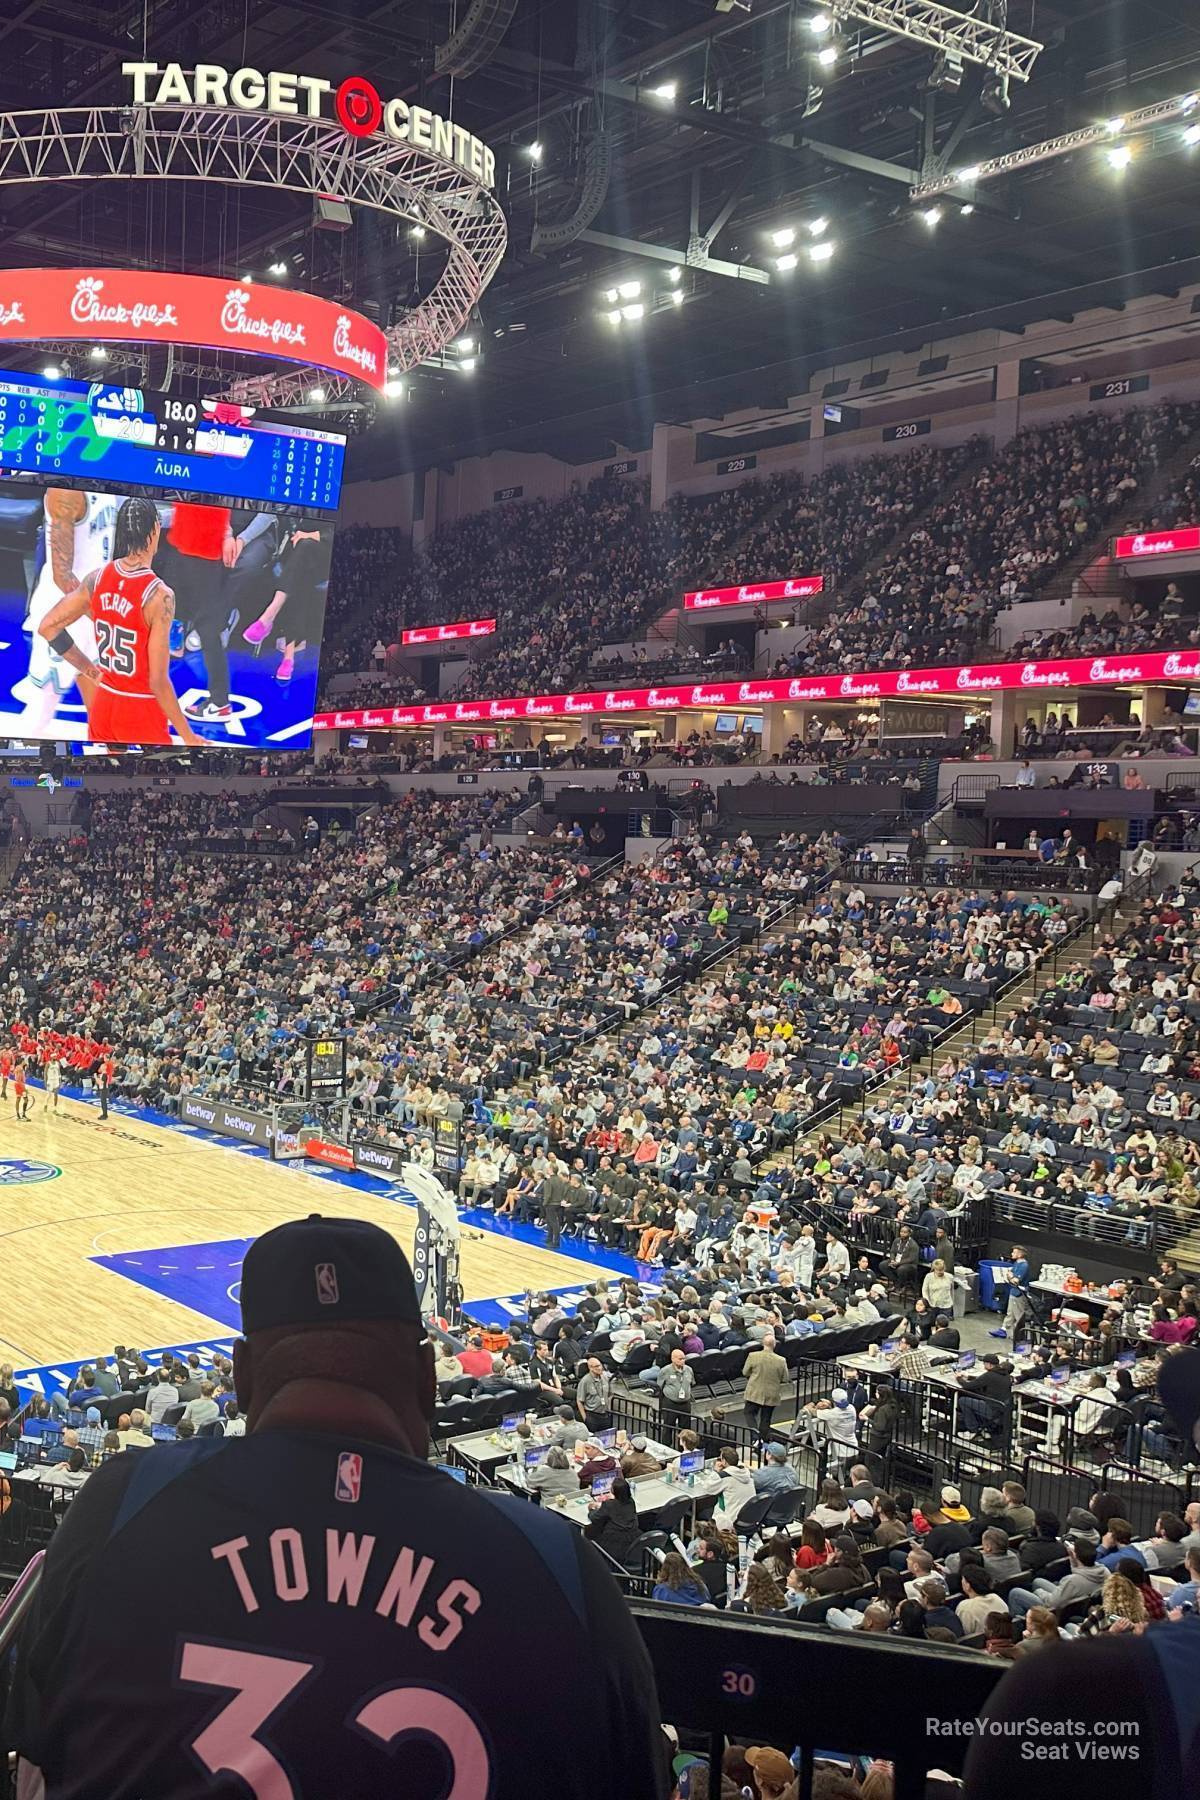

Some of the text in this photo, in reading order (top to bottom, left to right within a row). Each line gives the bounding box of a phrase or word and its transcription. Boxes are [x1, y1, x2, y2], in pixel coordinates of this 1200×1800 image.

[122, 62, 496, 189] TARGET CENTER
[37, 389, 50, 397] AST
[1105, 380, 1131, 396] 231
[0, 396, 7, 407] 0
[19, 400, 27, 409] 0
[38, 401, 46, 412] 0
[58, 404, 65, 414] 0
[164, 400, 197, 422] 18.0
[18, 414, 26, 423] 0
[37, 415, 45, 426] 0
[57, 418, 64, 428] 0
[117, 416, 144, 439] 20
[56, 431, 63, 441] 0
[895, 424, 917, 438] 230
[17, 440, 23, 450] 2
[35, 442, 44, 452] 0
[158, 435, 193, 449] 6 1 6
[207, 429, 226, 451] 31
[289, 439, 295, 449] 2
[303, 442, 309, 451] 2
[316, 443, 323, 453] 0
[15, 453, 22, 463] 3
[54, 457, 61, 467] 0
[287, 451, 294, 461] 0
[314, 456, 322, 466] 0
[328, 458, 334, 467] 2
[727, 460, 746, 471] 229
[286, 463, 294, 473] 12
[300, 466, 306, 475] 3
[285, 475, 292, 485] 0
[299, 478, 305, 487] 2
[325, 481, 331, 491] 0
[283, 488, 290, 498] 4
[311, 491, 317, 501] 2
[324, 494, 330, 503] 0
[100, 592, 134, 619] TERRY
[96, 618, 136, 677] 25
[887, 708, 945, 729] TAYLOR
[627, 772, 640, 780] 130
[1086, 764, 1108, 775] 132
[316, 1042, 335, 1056] 18.0
[186, 1102, 297, 1145] betway betway btwa
[359, 1148, 394, 1170] betway
[211, 1527, 481, 1651] TOWNS
[721, 1670, 756, 1696] 30
